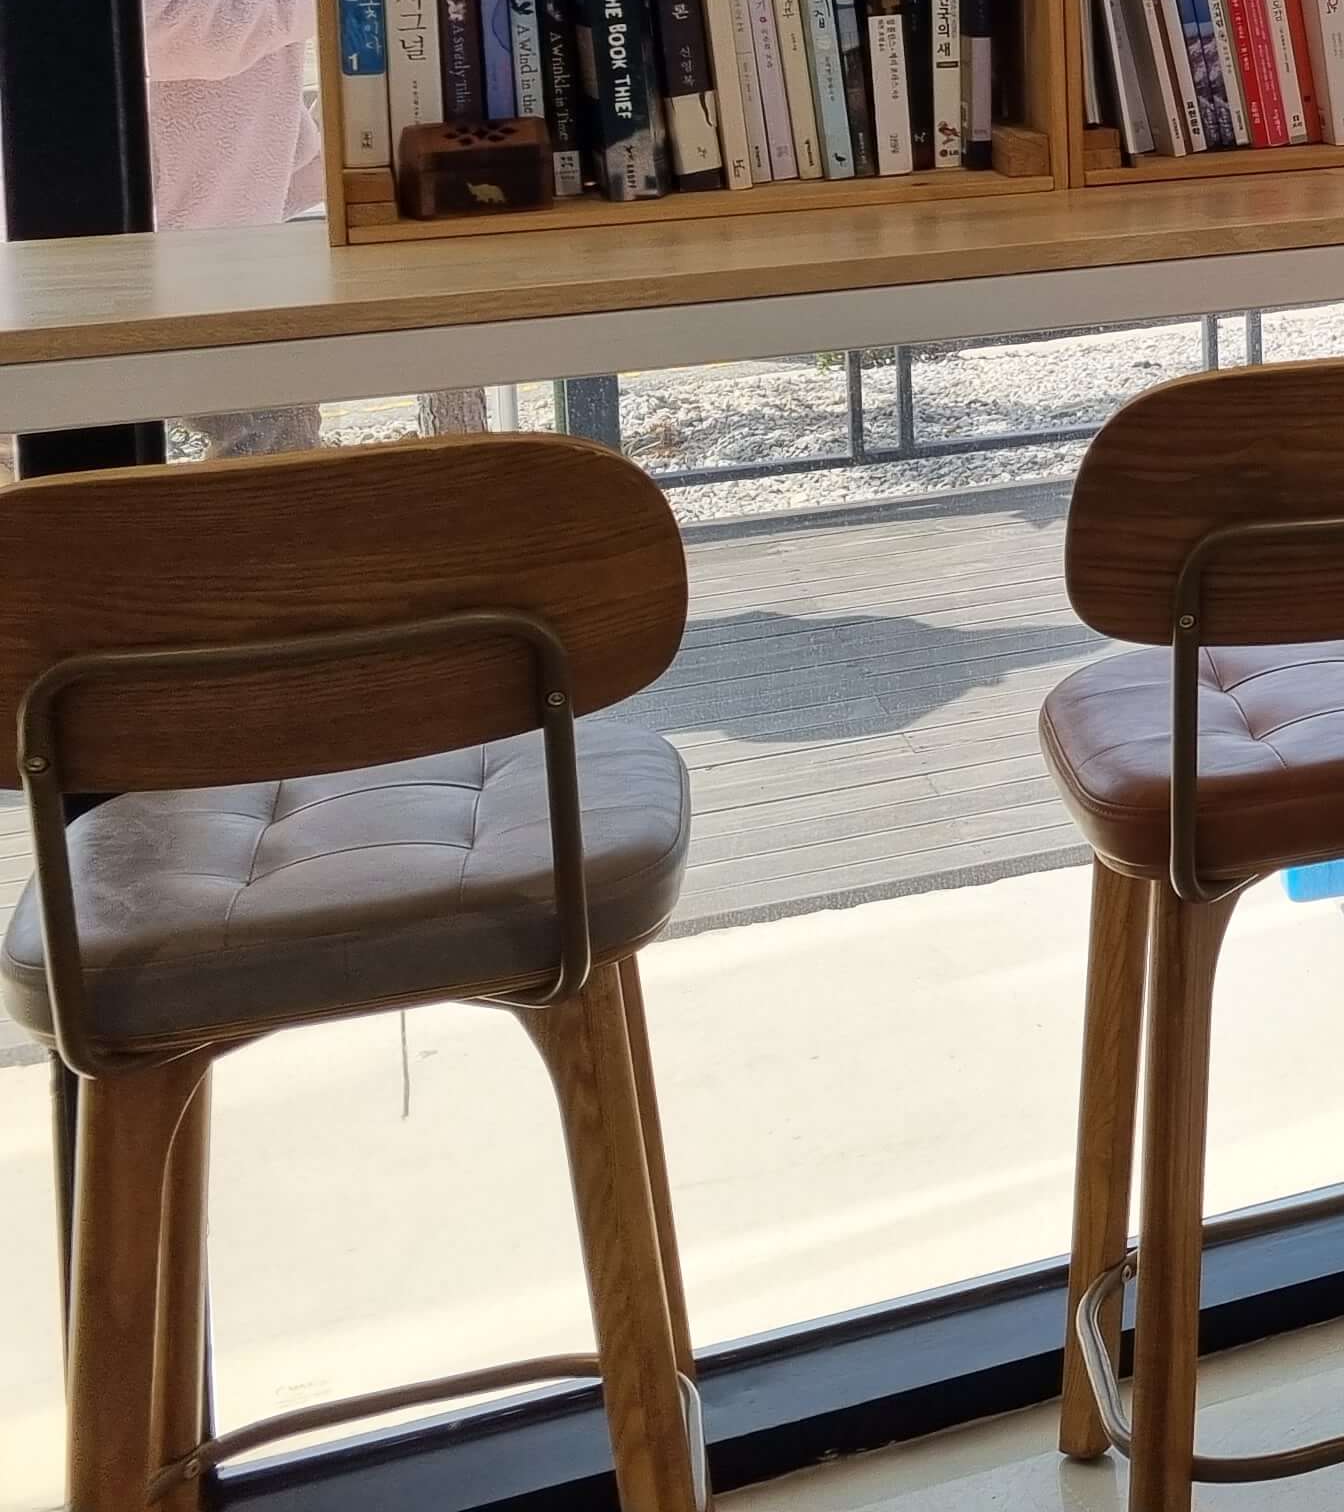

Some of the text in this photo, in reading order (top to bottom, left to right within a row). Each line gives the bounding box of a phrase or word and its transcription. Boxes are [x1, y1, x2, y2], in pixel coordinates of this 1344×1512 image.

[348, 53, 359, 72] 1
[518, 38, 539, 77] Wind
[607, 23, 629, 72] BOOK
[936, 43, 951, 59] 새
[550, 44, 571, 96] Wrinkle
[520, 91, 538, 115] the
[613, 74, 633, 120] THIEF
[556, 110, 574, 141] Time
